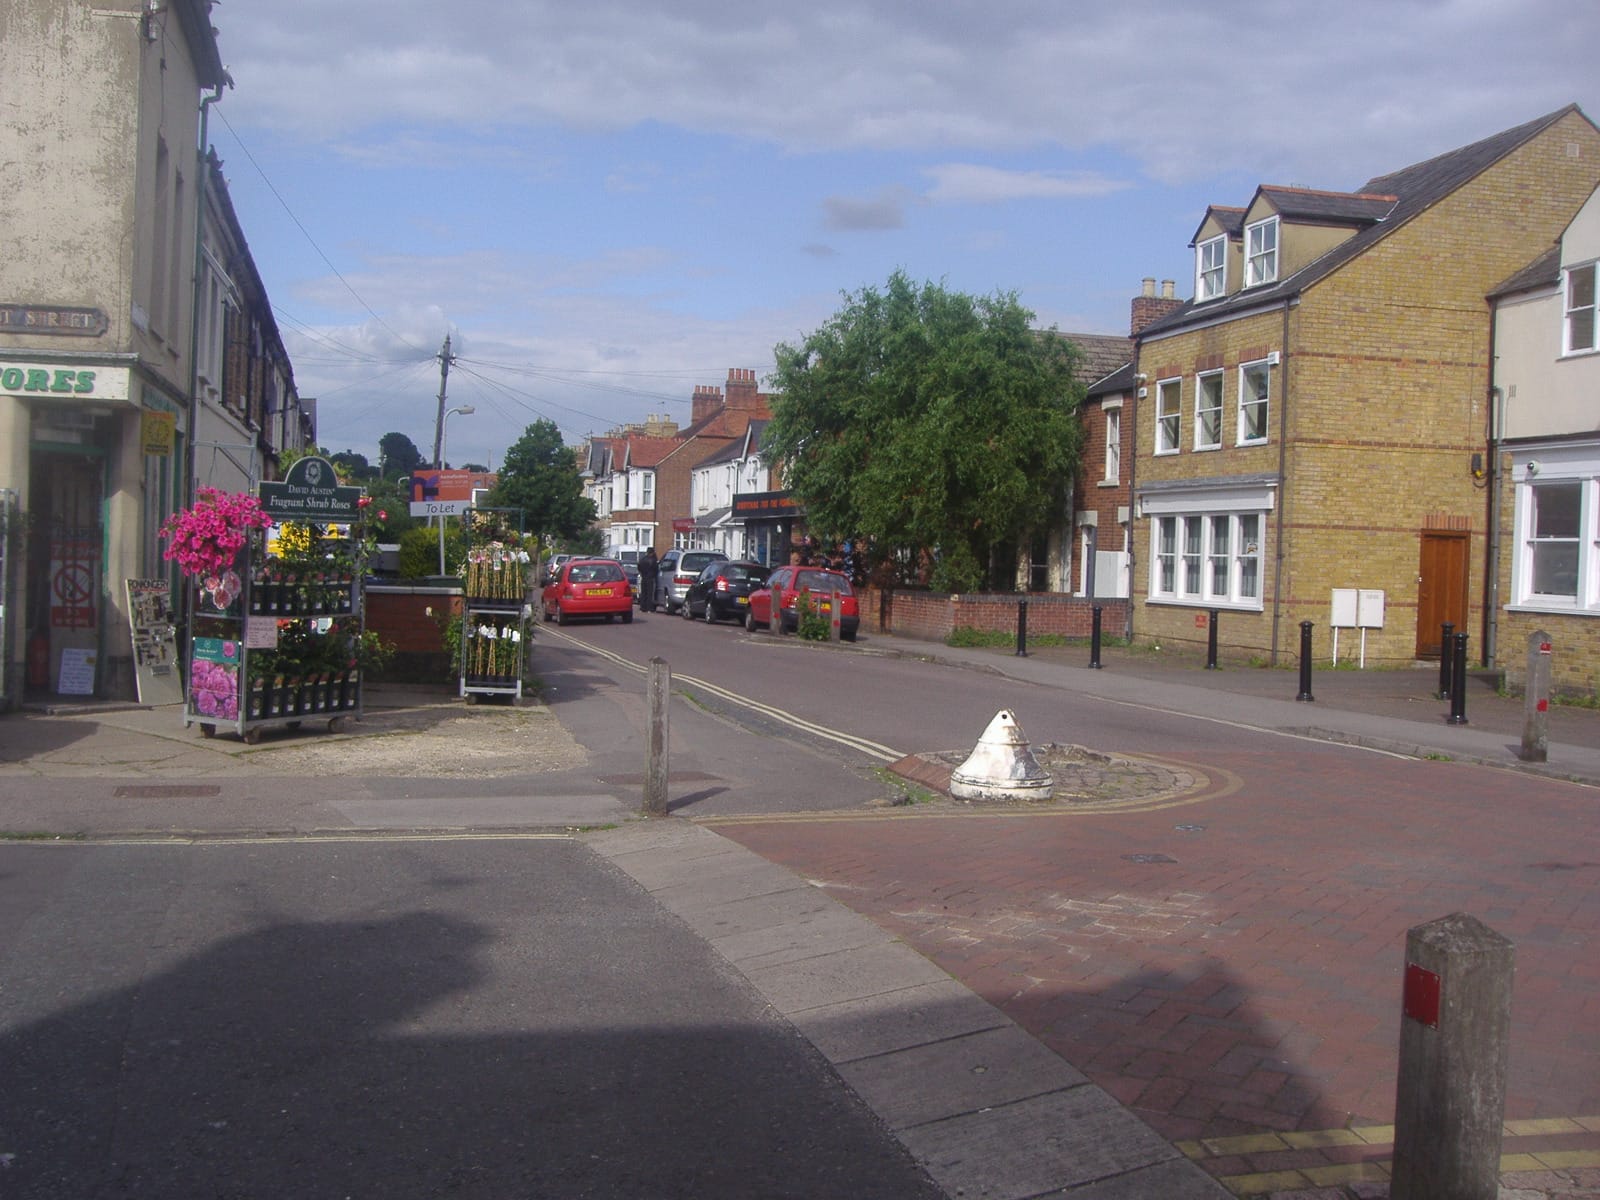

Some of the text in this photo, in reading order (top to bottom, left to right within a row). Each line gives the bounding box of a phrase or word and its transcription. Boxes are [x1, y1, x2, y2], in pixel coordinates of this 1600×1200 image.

[25, 310, 92, 328] STREET
[0, 367, 97, 394] ORES
[269, 495, 351, 509] Fragrant Shrub Roses
[426, 503, 455, 514] To Let
